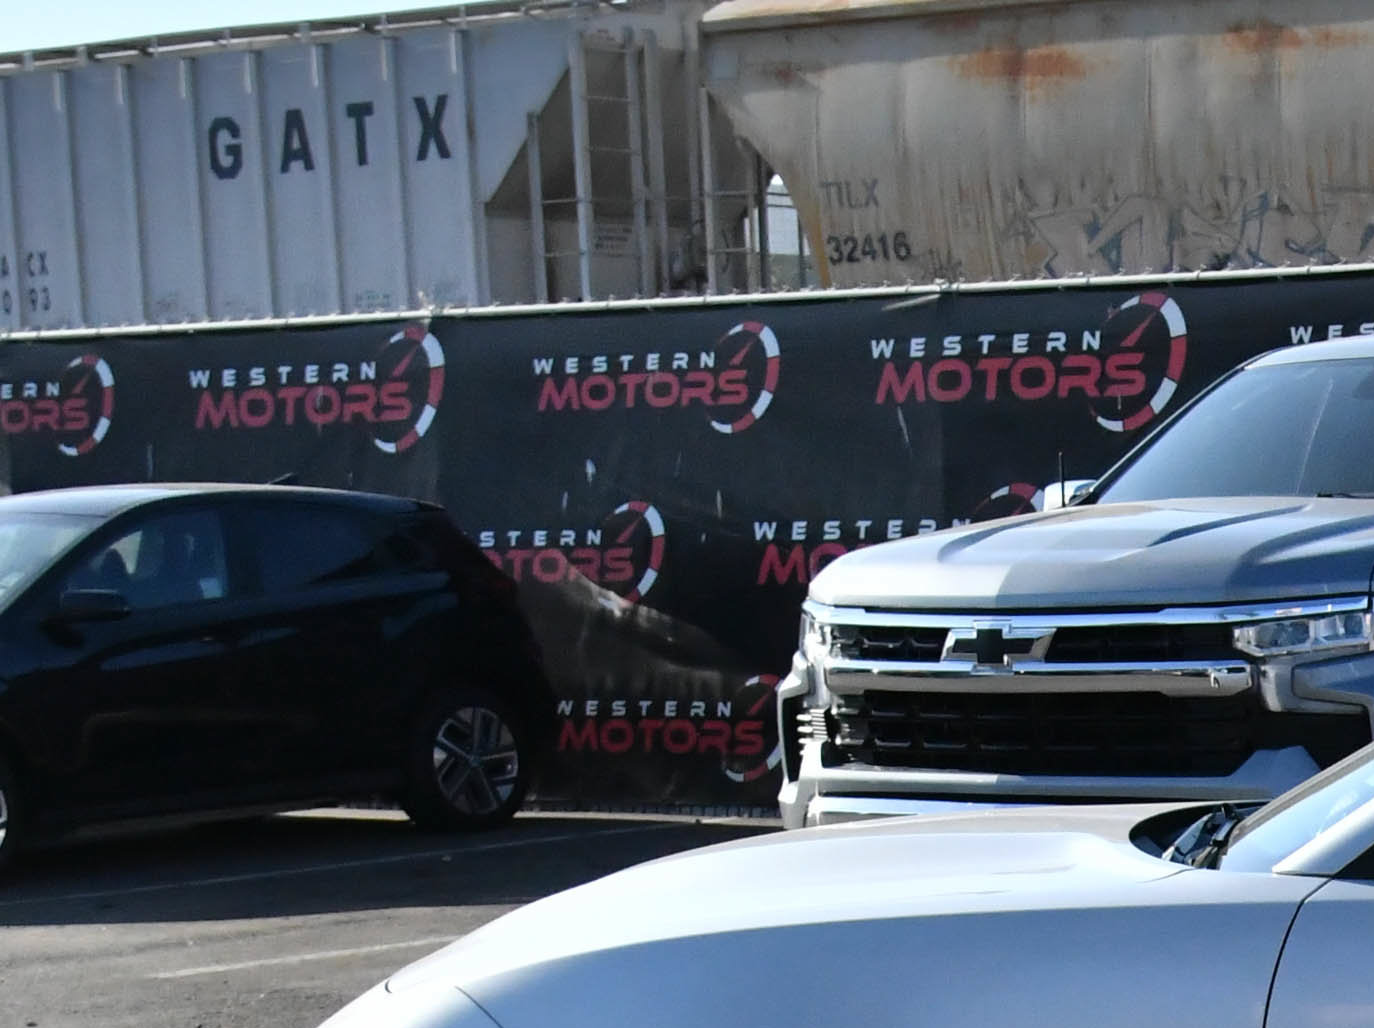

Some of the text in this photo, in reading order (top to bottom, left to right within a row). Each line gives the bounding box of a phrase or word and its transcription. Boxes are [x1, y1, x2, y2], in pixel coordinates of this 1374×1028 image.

[208, 94, 452, 180] GATX
[826, 231, 911, 265] 32416
[870, 330, 1102, 359] WESTERN
[188, 361, 377, 388] WESTERN
[532, 351, 716, 375] WESTERN
[875, 352, 1147, 405] MOTORS
[194, 381, 412, 430] MOTORS
[537, 369, 749, 412] MOTORS
[557, 719, 765, 755] MOTORS
